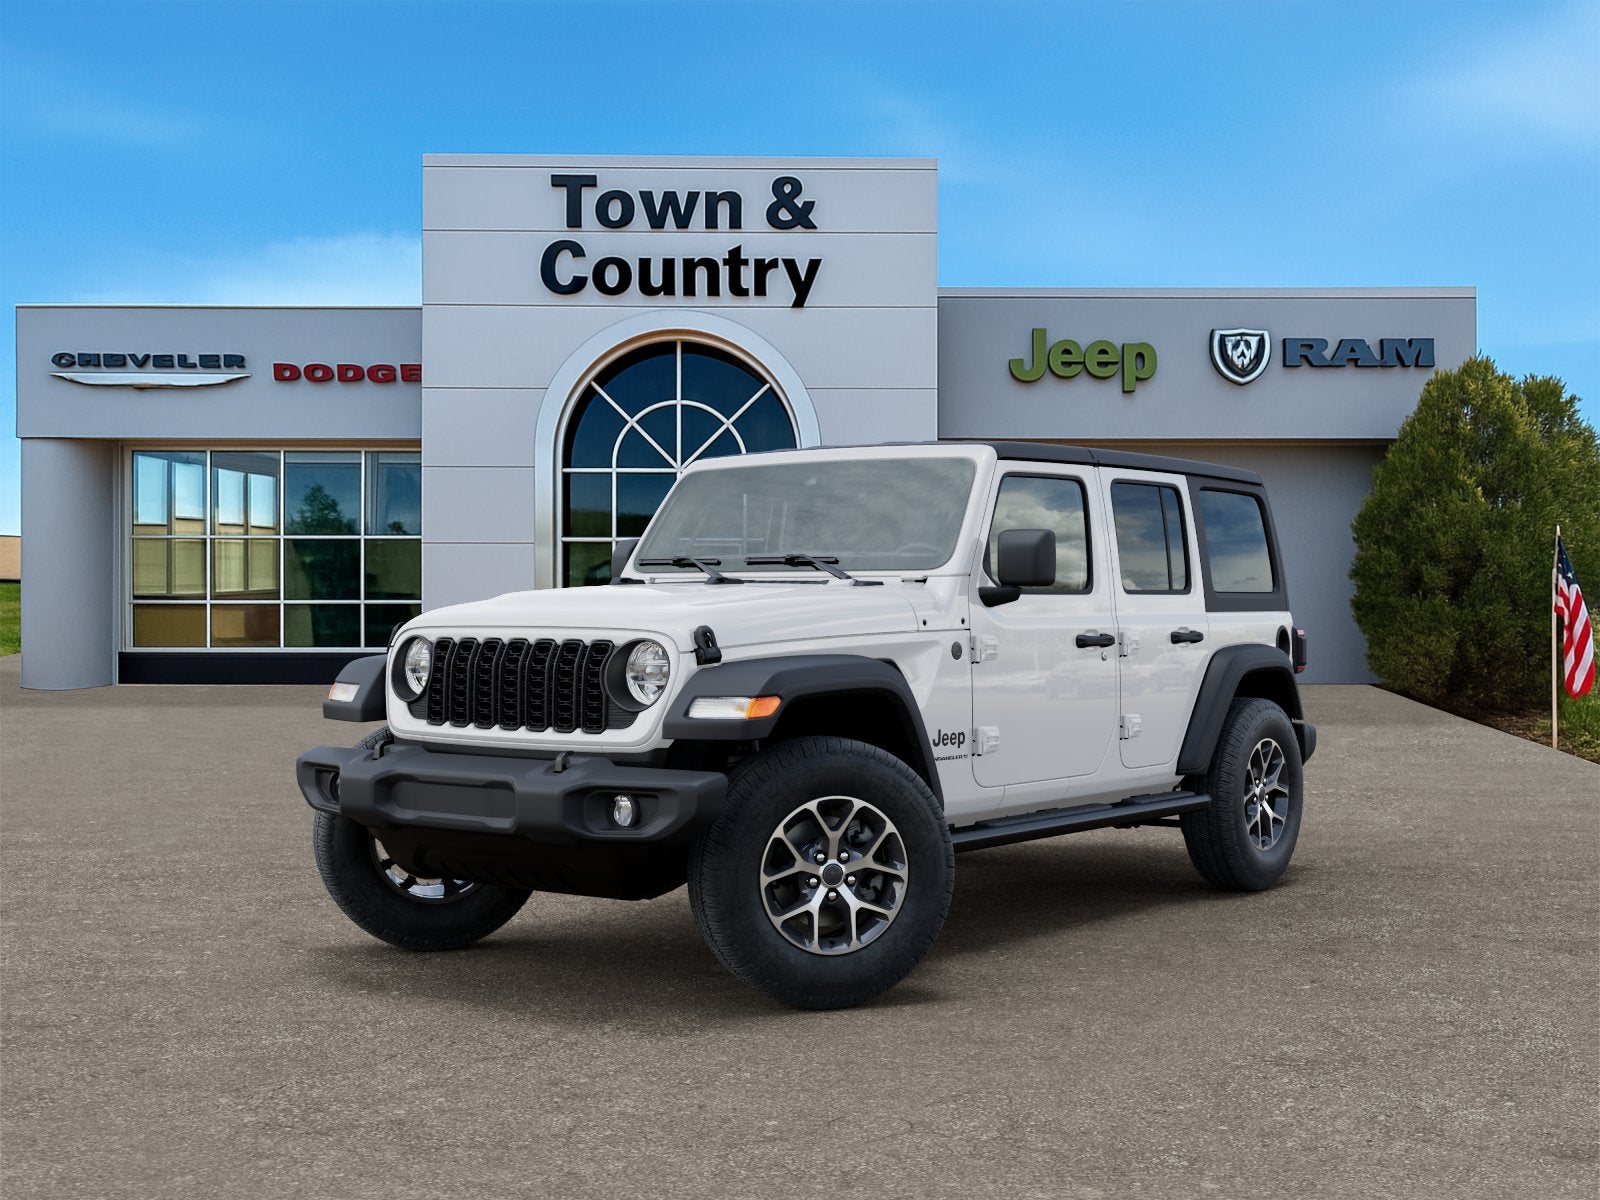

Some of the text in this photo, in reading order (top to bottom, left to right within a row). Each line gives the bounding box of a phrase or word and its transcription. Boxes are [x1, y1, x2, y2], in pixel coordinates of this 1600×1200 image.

[550, 174, 818, 230] Town &
[540, 239, 822, 308] Country
[273, 362, 422, 383] DODGE
[1009, 327, 1158, 393] Jeep
[1282, 337, 1435, 368] RAM
[932, 728, 966, 749] Jeep
